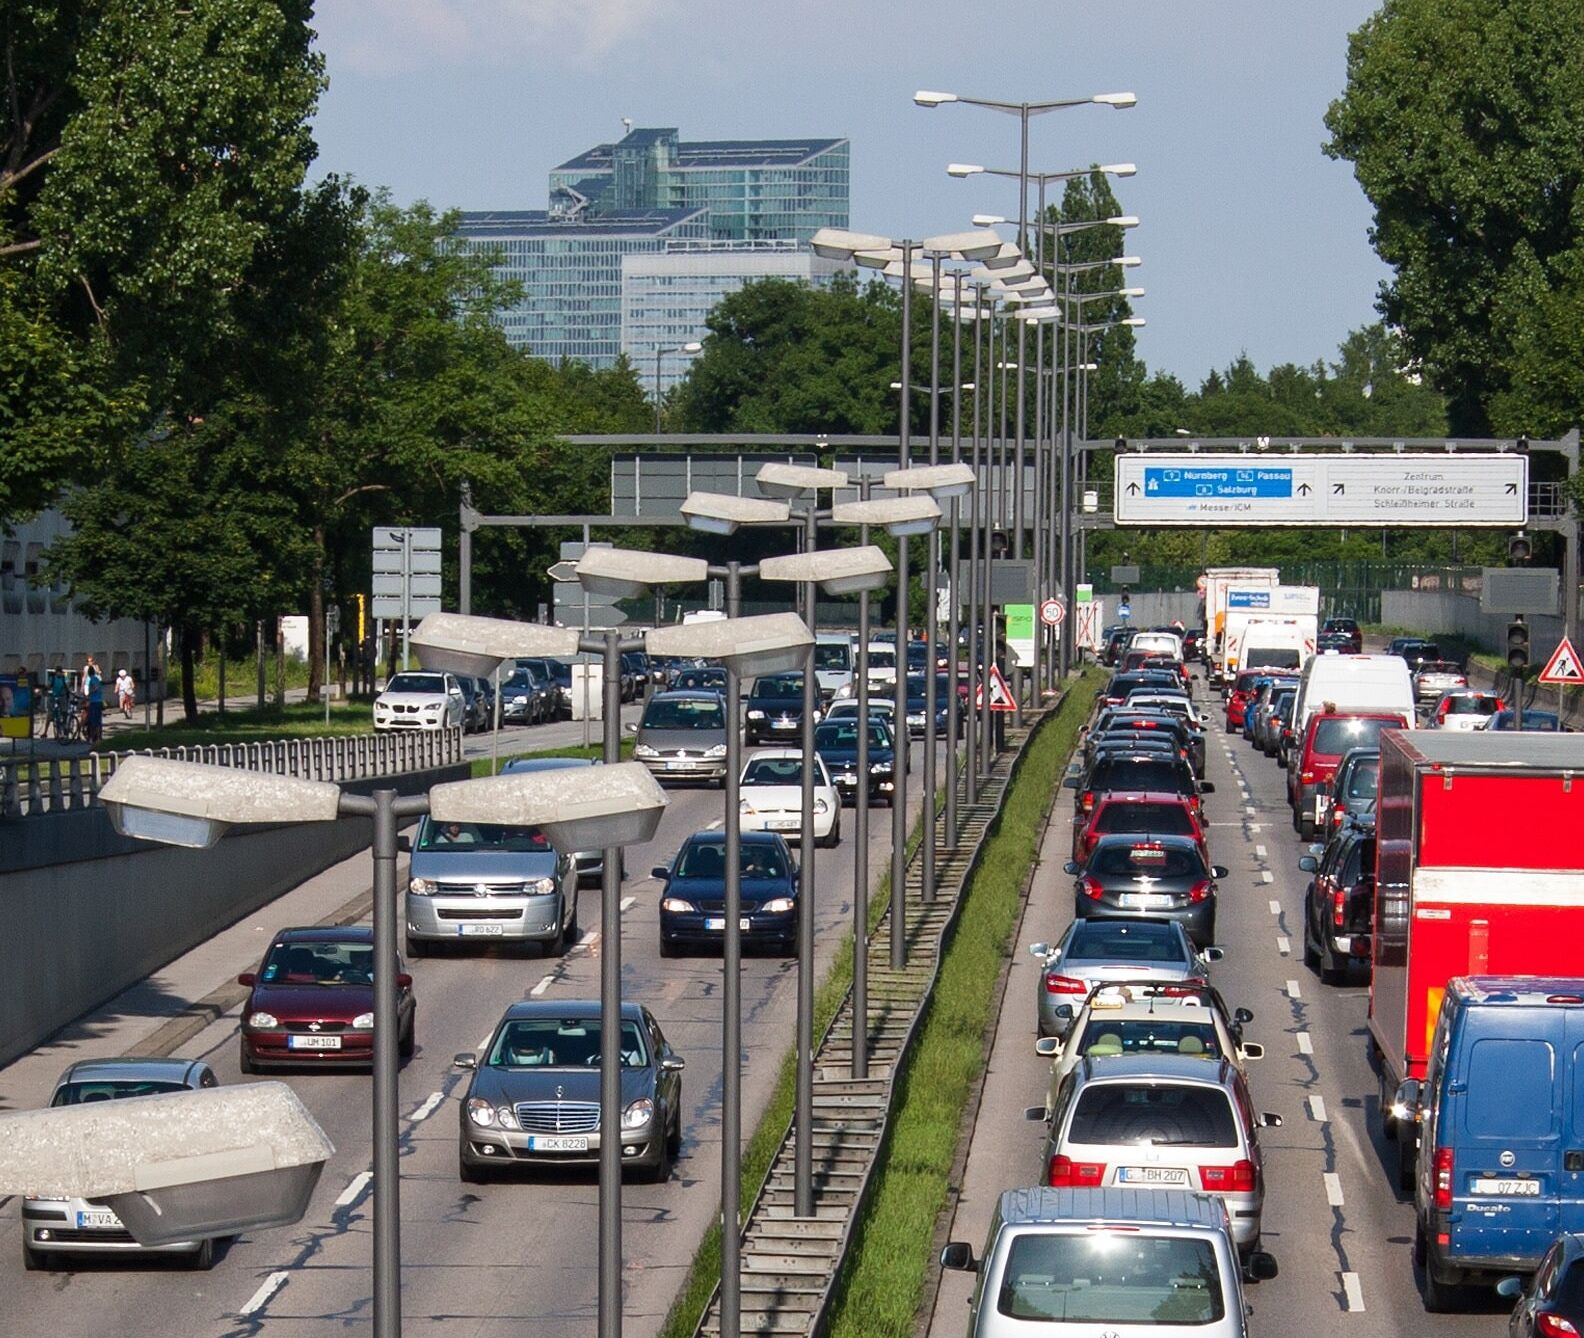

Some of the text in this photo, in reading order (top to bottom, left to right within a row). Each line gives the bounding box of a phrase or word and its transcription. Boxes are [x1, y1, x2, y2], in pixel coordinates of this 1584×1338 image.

[1258, 472, 1291, 480] Passau
[1404, 473, 1444, 481] Zentrum
[1217, 485, 1258, 496] Salzburg
[1046, 608, 1058, 618] 50
[1147, 1170, 1162, 1180] BH
[1164, 1171, 1184, 1181] 207
[1466, 1203, 1511, 1212] Ducato
